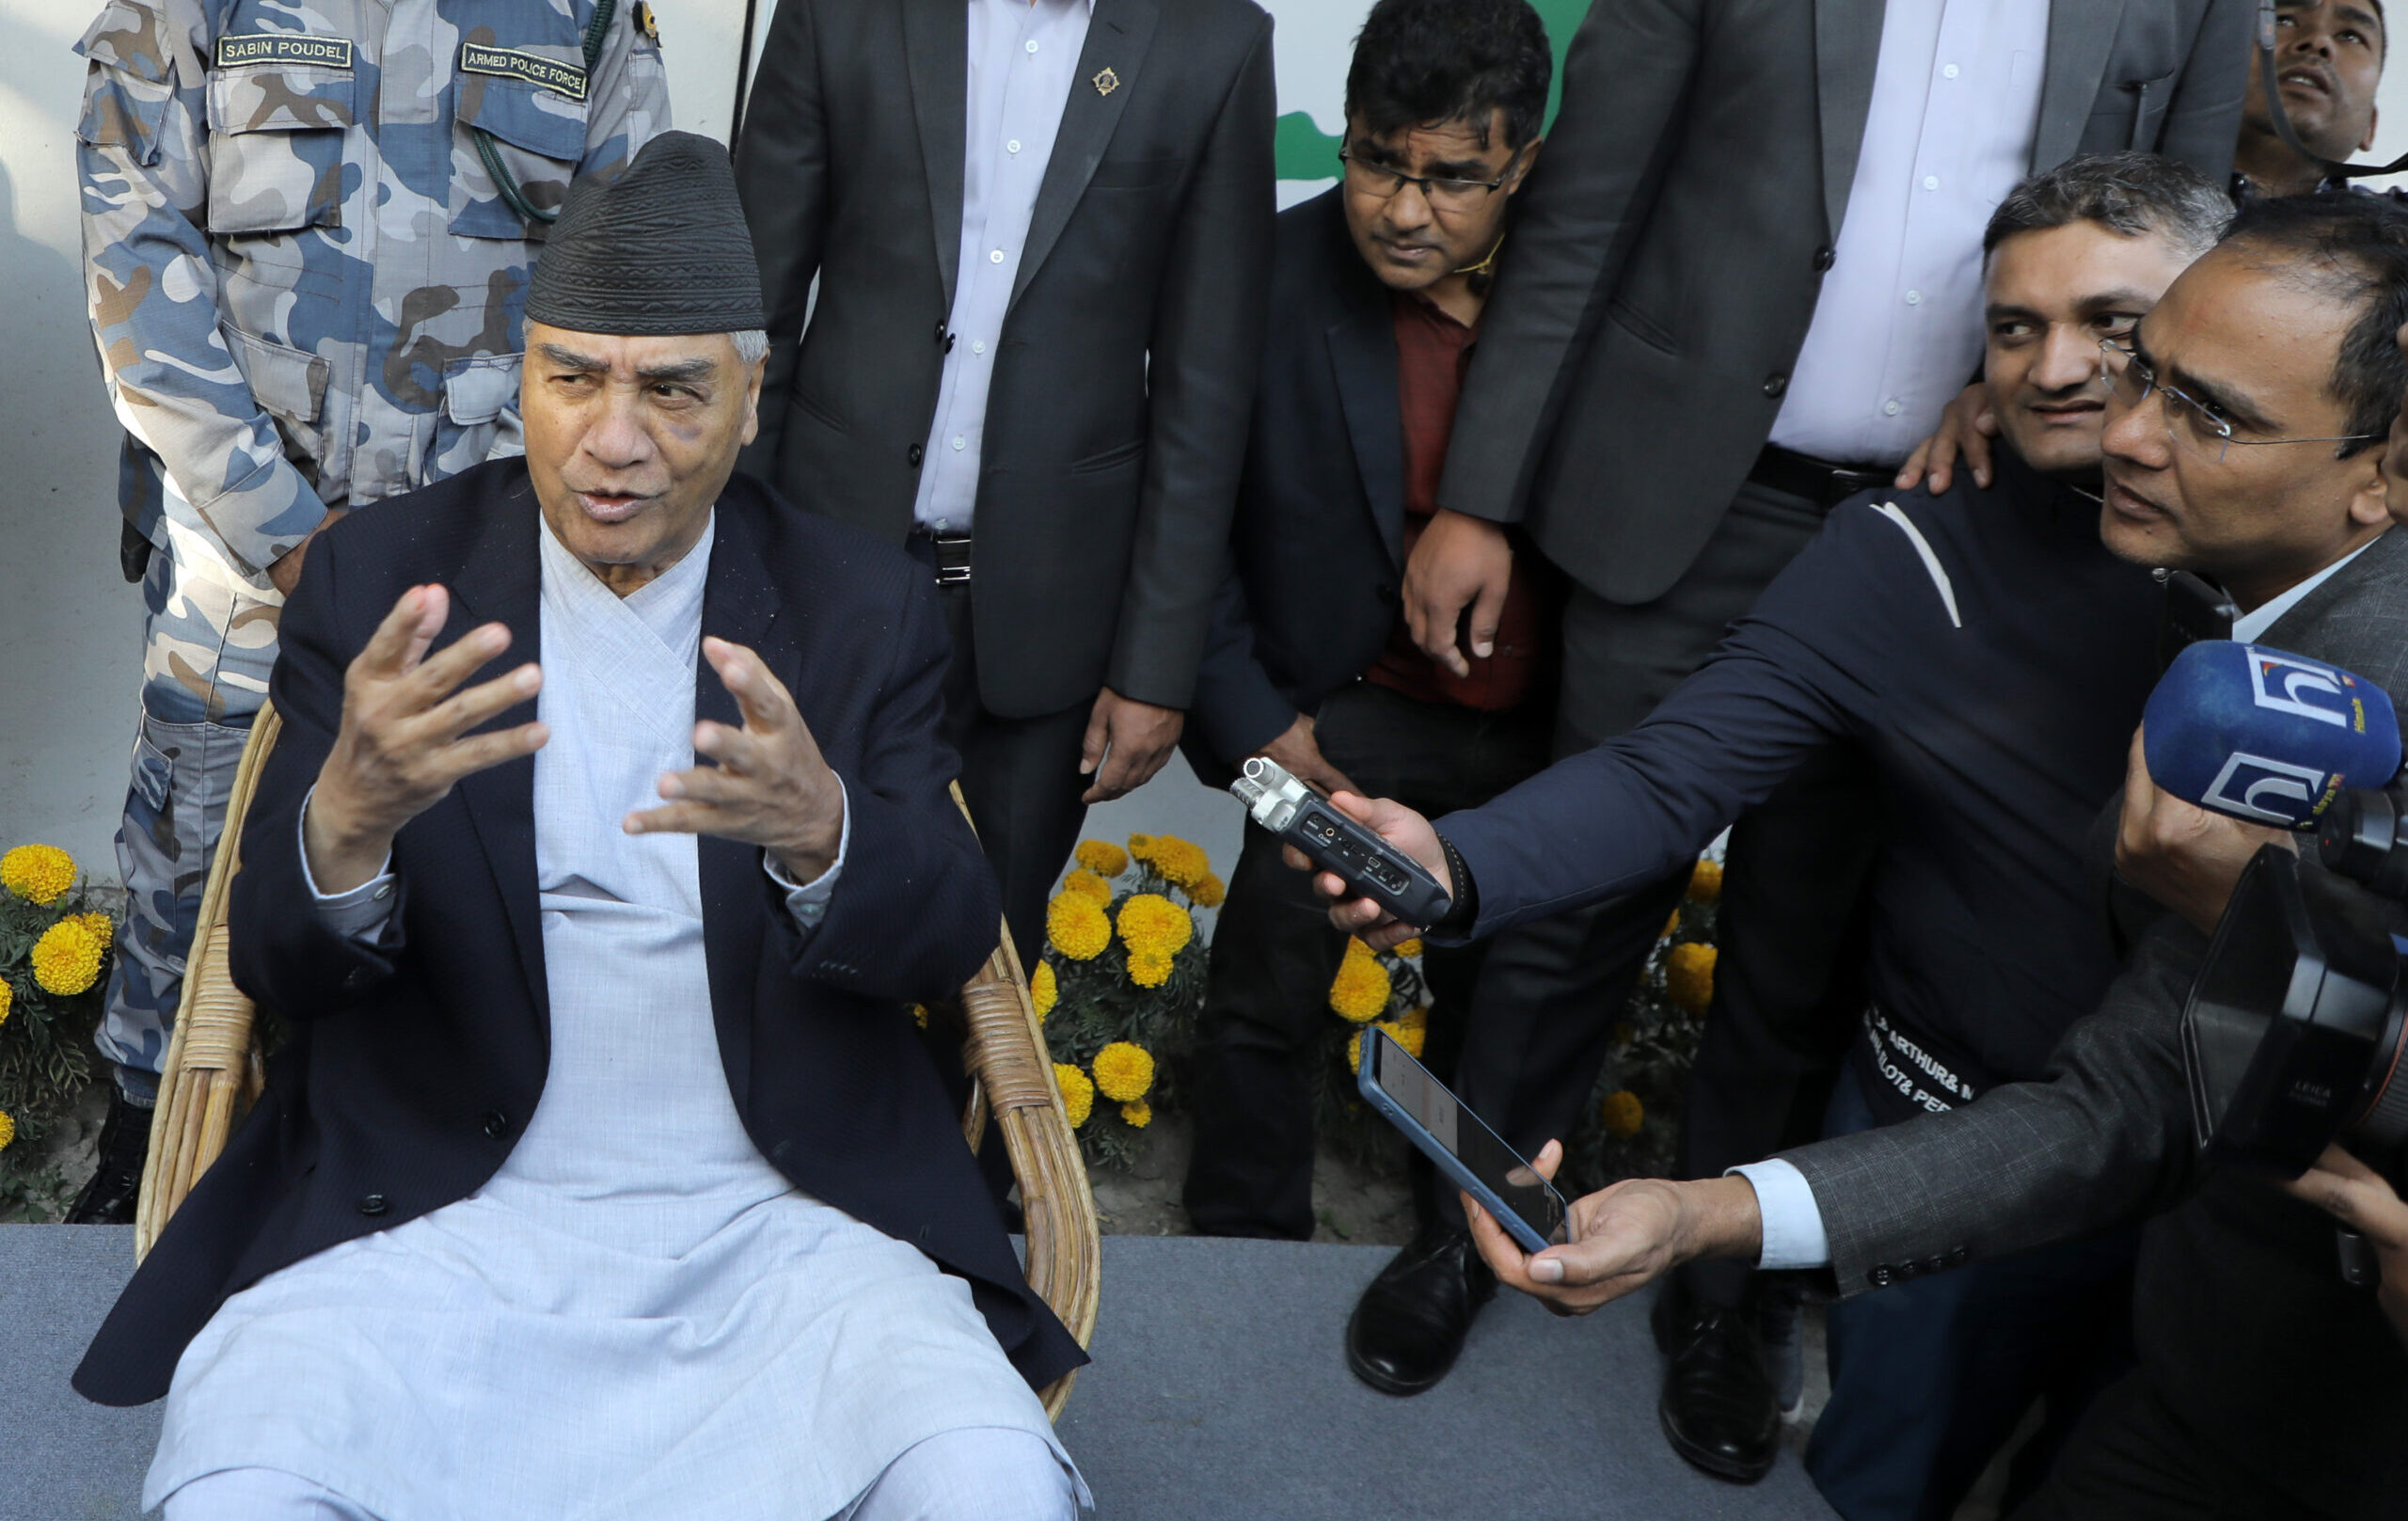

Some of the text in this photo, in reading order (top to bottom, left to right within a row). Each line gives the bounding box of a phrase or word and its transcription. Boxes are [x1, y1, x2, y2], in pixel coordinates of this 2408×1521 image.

[226, 41, 346, 60] SABIN POUDEL
[467, 53, 582, 89] ARMED POLICE FORCE
